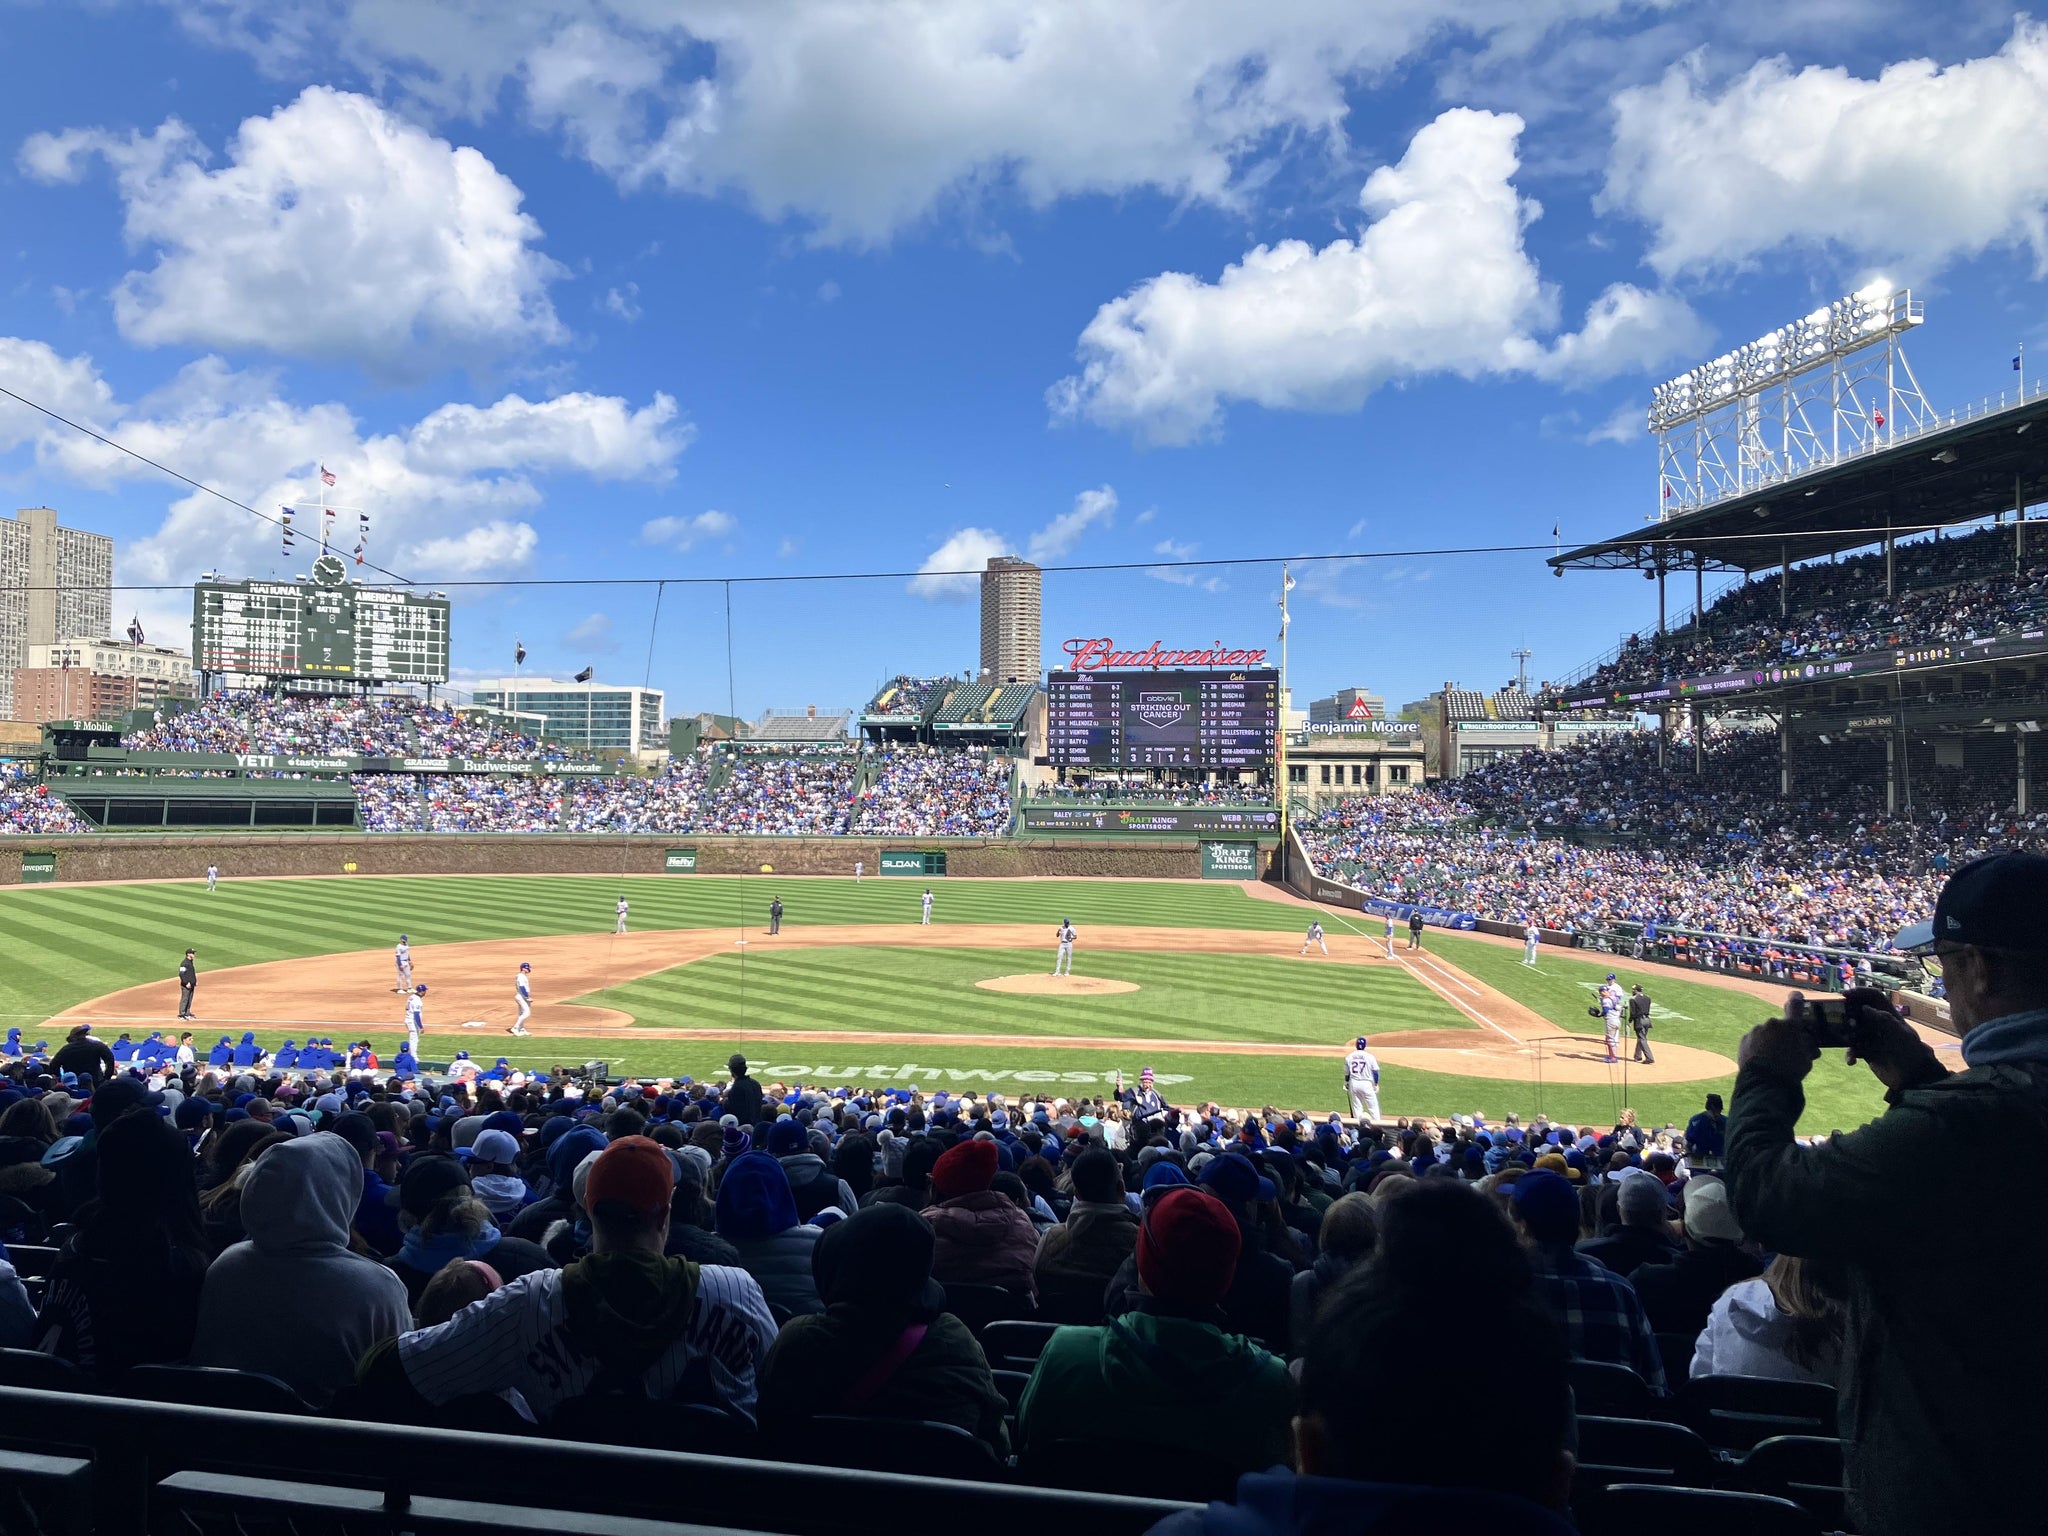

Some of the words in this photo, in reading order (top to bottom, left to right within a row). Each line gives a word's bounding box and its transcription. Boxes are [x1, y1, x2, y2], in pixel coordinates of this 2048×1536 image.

[250, 583, 302, 596] NATIONAL
[355, 592, 404, 604] AMERICAN
[329, 614, 336, 624] 8
[324, 653, 331, 662] 2
[1062, 637, 1266, 671] Budweiser
[1917, 651, 1922, 661] 1
[1944, 648, 1950, 658] 2
[1782, 670, 1788, 679] 0
[1834, 662, 1853, 672] HAPP
[1230, 673, 1246, 681] Cubs
[1714, 679, 1746, 689] SPORTSBOOK
[83, 722, 113, 731] Mobile
[1302, 720, 1367, 735] Benjamin
[1371, 721, 1418, 733] Moore
[235, 755, 274, 767] YETI
[295, 758, 348, 768] tastytrade
[403, 758, 449, 766] GRAINGER
[1146, 754, 1152, 762] 2
[1168, 754, 1173, 762] 1
[1183, 754, 1190, 762] 4
[557, 762, 601, 772] Advocate
[1211, 849, 1250, 857] DRAFT
[712, 1060, 1134, 1084] Southwest
[1352, 1062, 1366, 1073] 27
